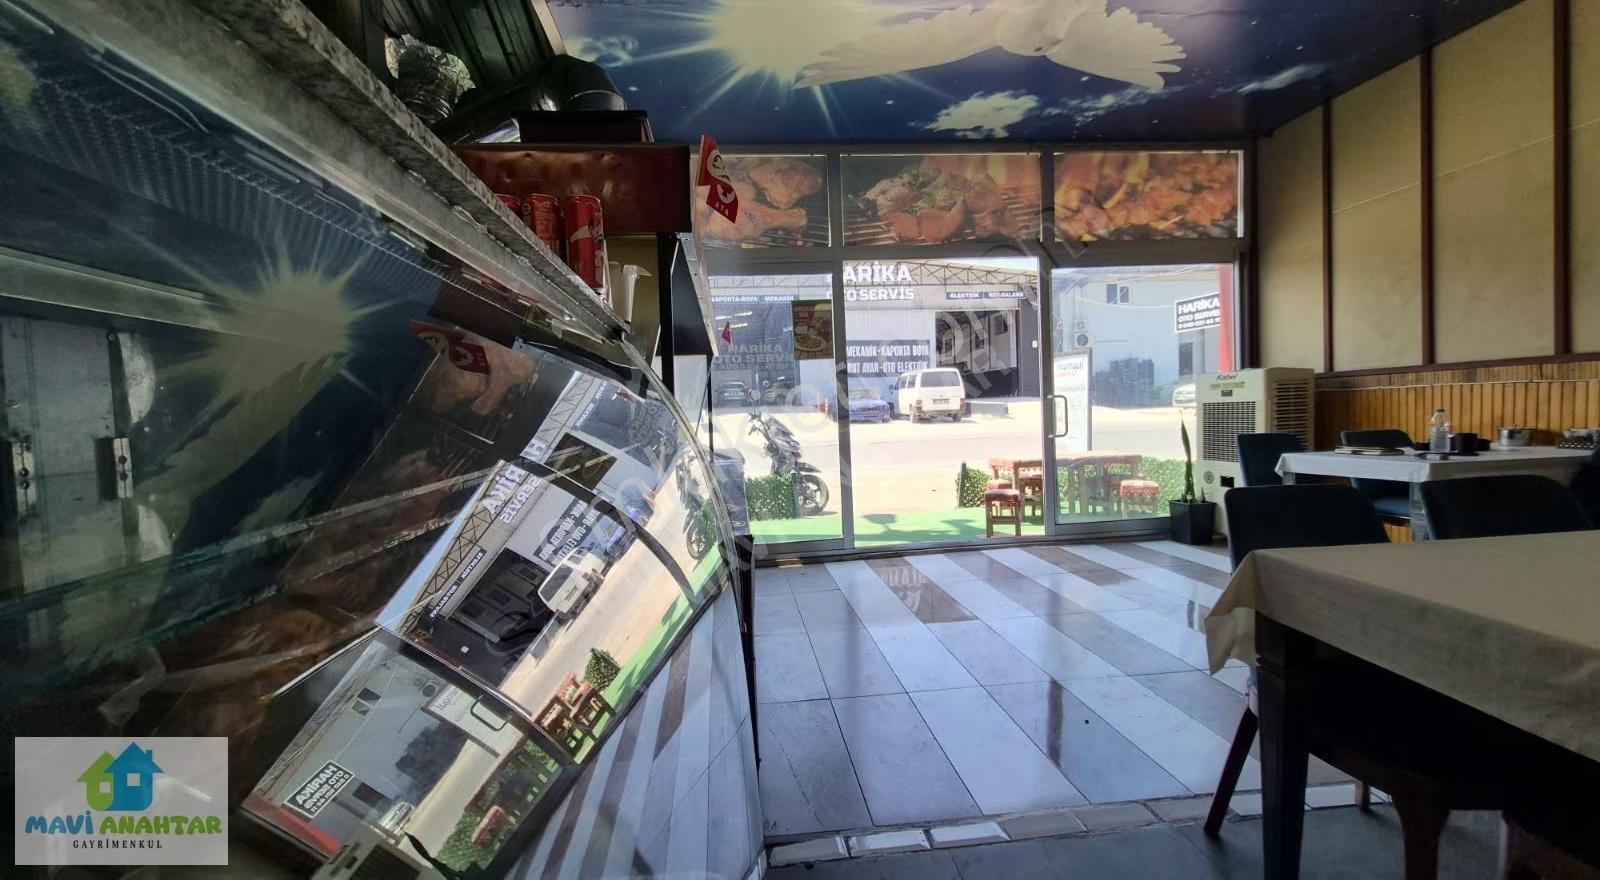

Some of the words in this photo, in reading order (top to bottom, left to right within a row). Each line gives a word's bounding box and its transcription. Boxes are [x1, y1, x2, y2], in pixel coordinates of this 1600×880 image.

[842, 261, 912, 283] ARİKA
[859, 286, 914, 300] SERVİS
[1177, 296, 1221, 315] HARİKA
[1178, 314, 1193, 323] OTO
[912, 345, 929, 356] BOYA
[847, 362, 860, 374] ROT
